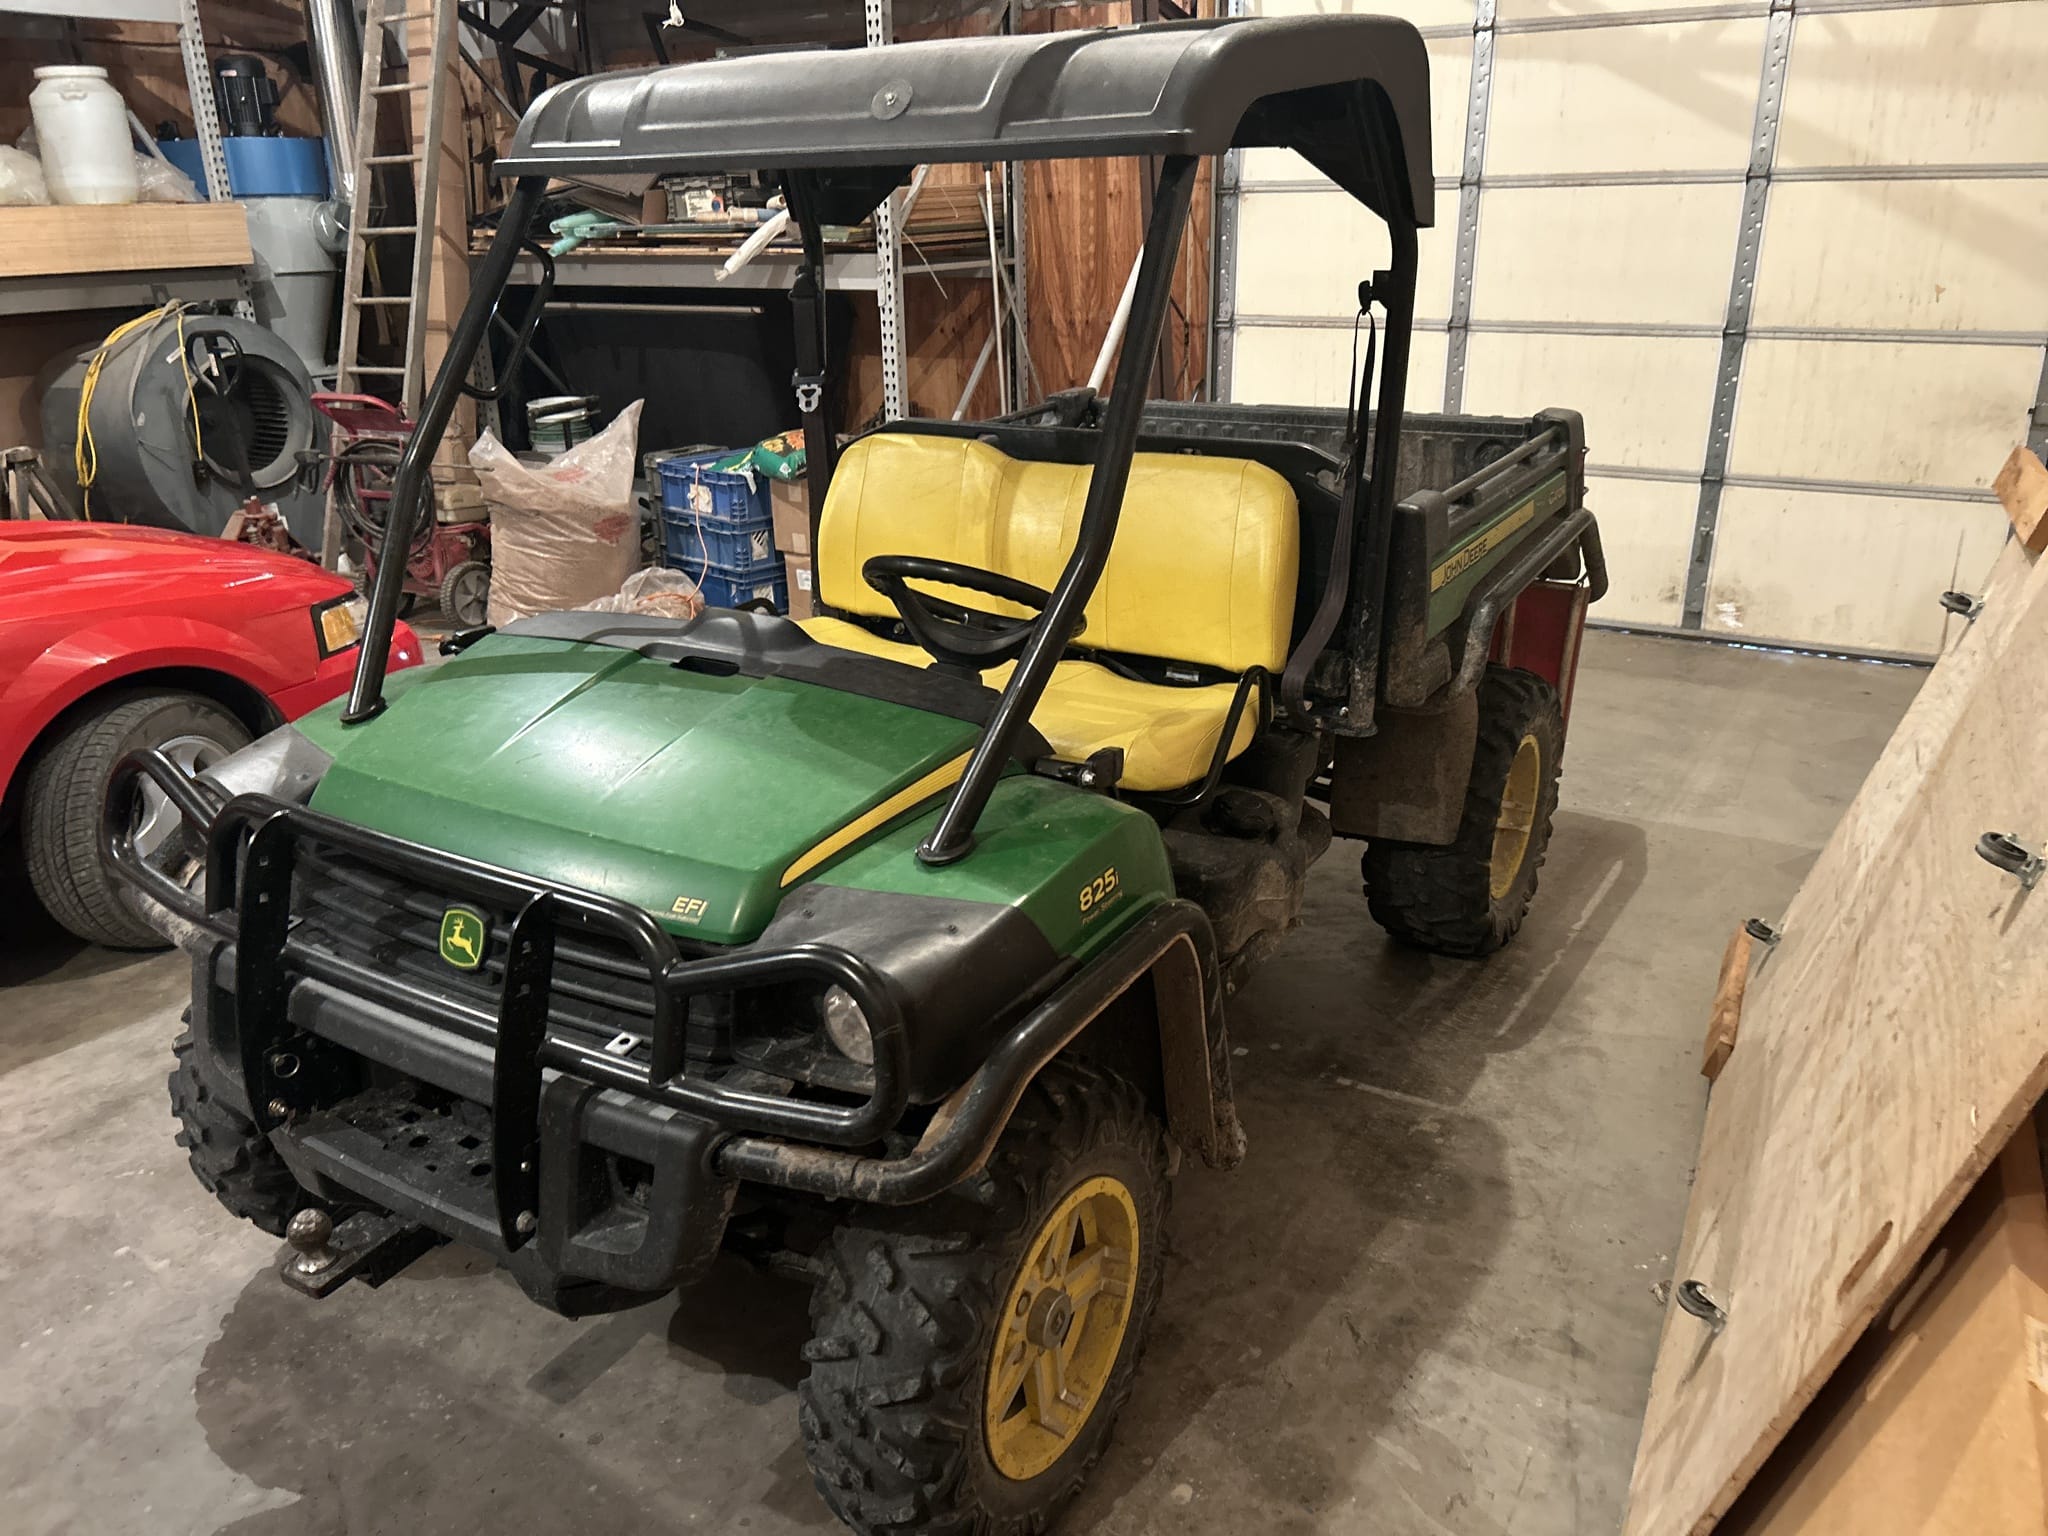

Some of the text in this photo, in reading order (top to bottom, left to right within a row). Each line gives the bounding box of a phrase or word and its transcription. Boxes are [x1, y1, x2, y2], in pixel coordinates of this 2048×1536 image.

[1441, 538, 1488, 586] JOHN DEERE
[671, 895, 708, 917] EFI
[1079, 866, 1119, 912] 825i
